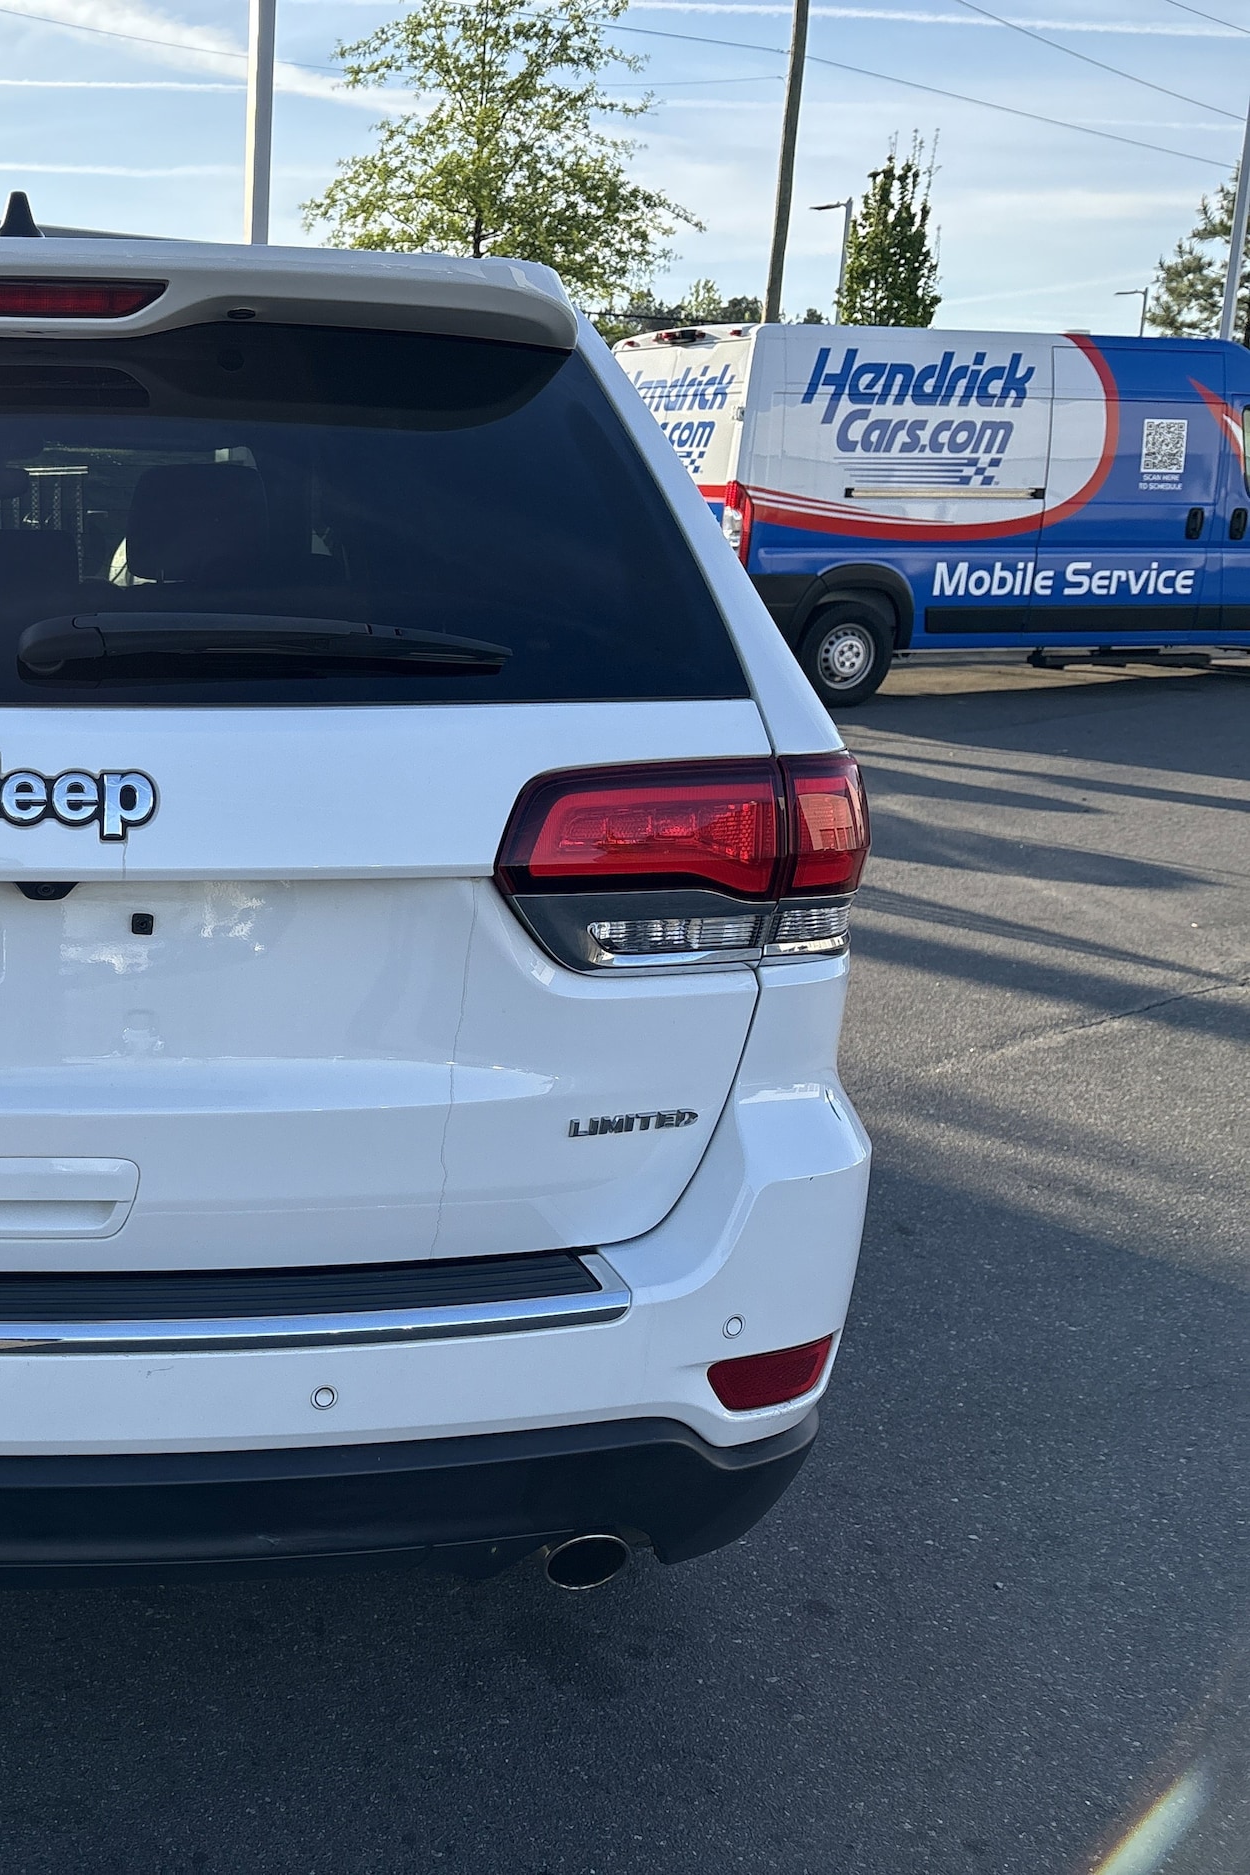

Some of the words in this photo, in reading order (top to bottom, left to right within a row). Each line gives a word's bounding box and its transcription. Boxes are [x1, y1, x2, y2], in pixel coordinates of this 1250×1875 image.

[627, 363, 736, 412] endrick
[801, 347, 1036, 424] Hendrick
[836, 408, 1014, 454] Cars.com
[932, 561, 1054, 596] Mobile
[1063, 561, 1195, 595] Service
[568, 1108, 699, 1137] LIMITED
